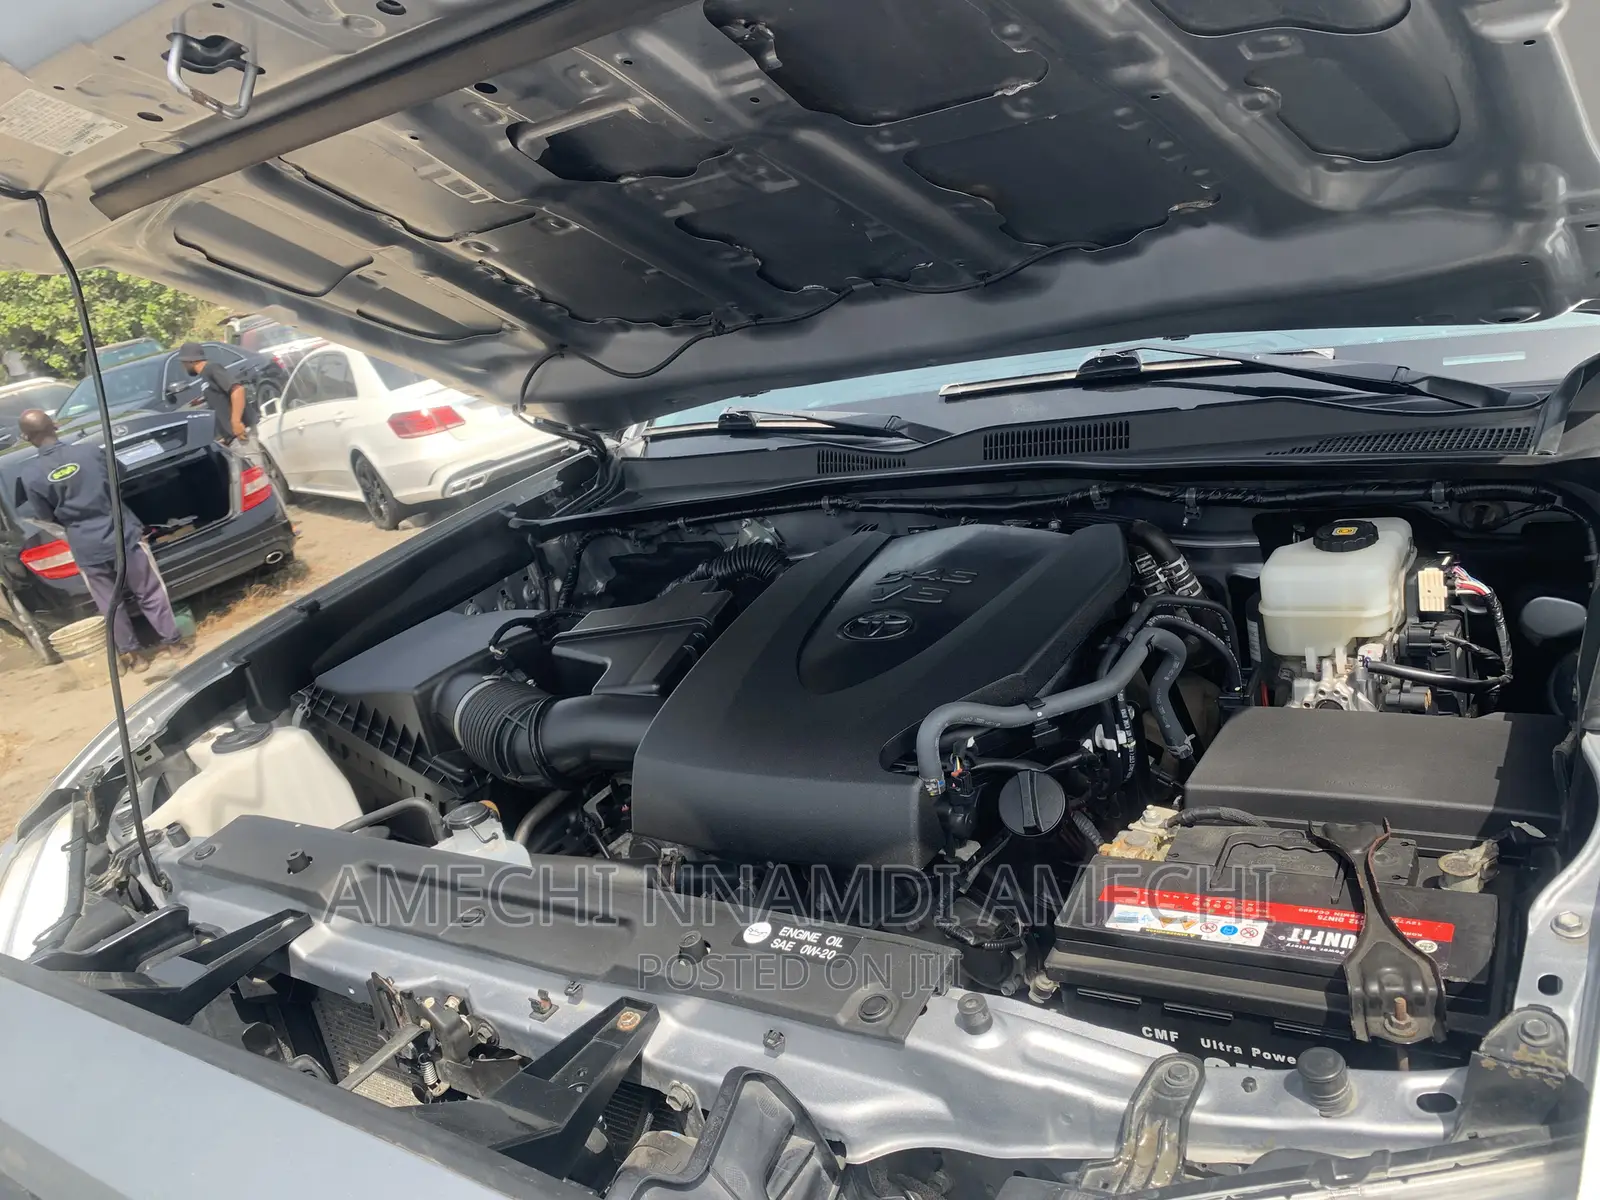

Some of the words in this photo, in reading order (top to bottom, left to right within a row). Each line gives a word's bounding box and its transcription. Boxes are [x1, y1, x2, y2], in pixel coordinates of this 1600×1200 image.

[870, 584, 950, 604] V6
[778, 926, 822, 944] ENGINE
[825, 935, 844, 949] OIL
[1285, 942, 1317, 952] Battery
[770, 938, 796, 952] SAE
[799, 944, 837, 960] 0W-20
[1319, 947, 1345, 955] Power
[1141, 1026, 1179, 1043] CMF
[1200, 1037, 1243, 1055] Ultra
[1251, 1047, 1297, 1065] Powe
